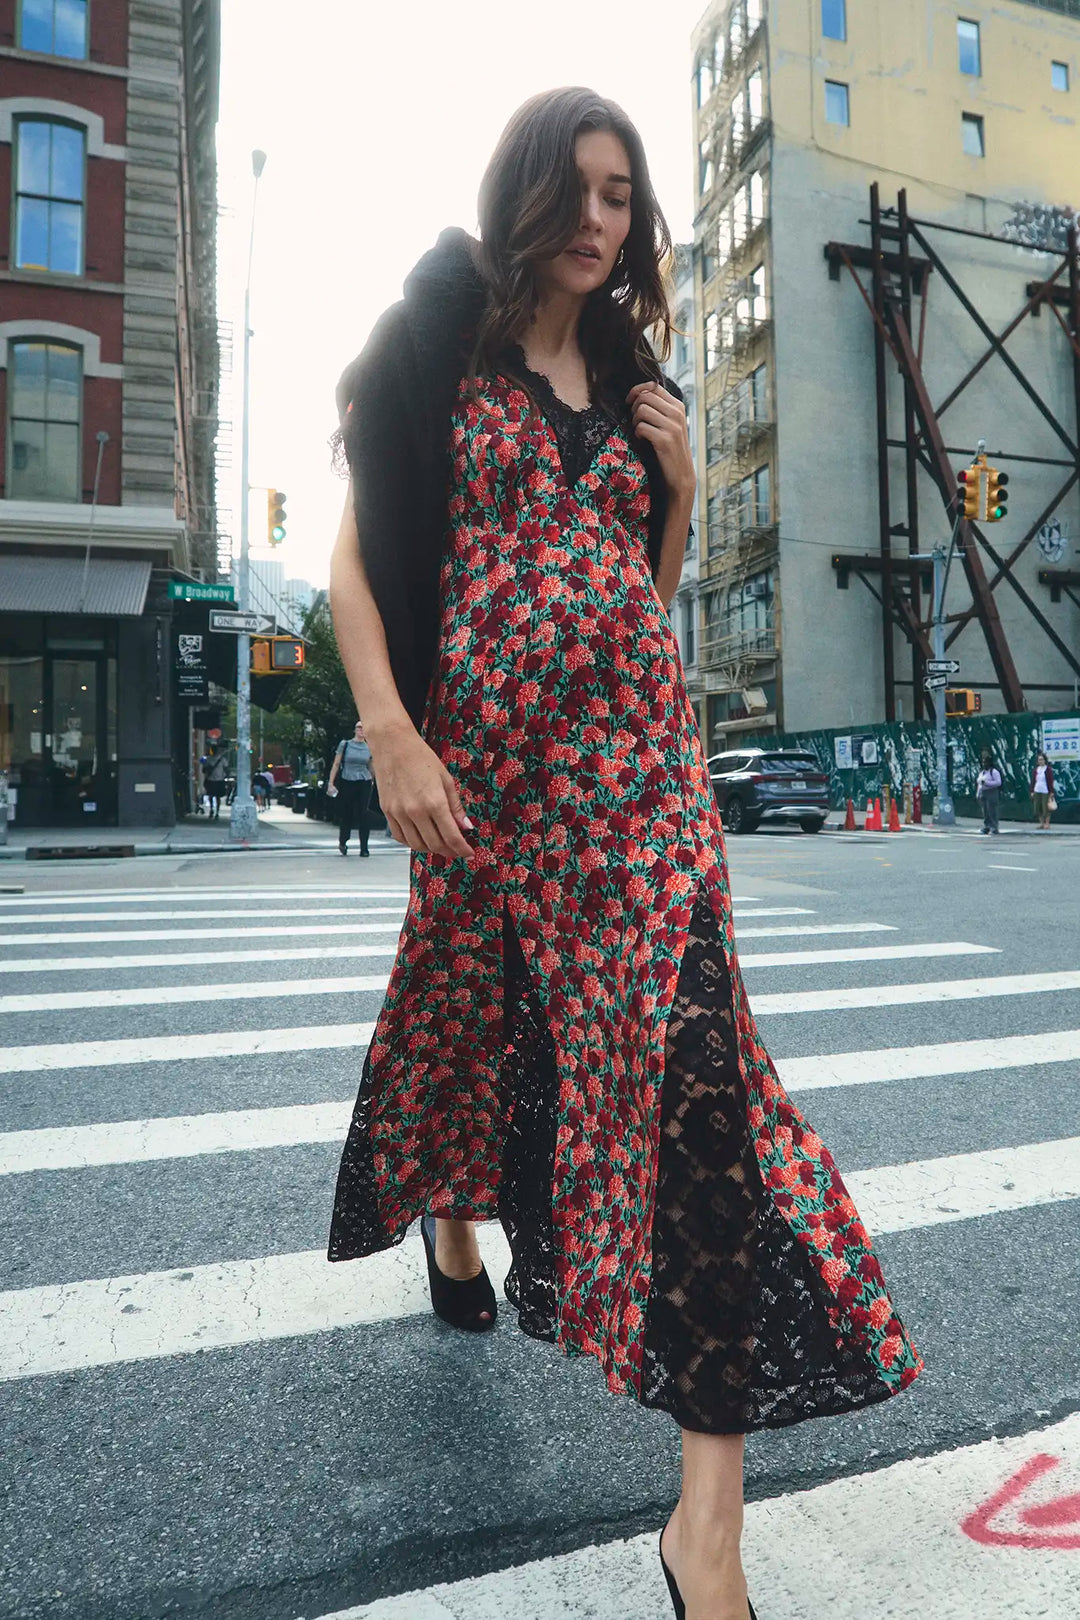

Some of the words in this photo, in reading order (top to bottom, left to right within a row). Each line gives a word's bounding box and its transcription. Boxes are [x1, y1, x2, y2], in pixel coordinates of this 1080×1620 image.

[174, 585, 183, 597] W
[186, 586, 230, 601] Broadway
[217, 616, 235, 626] ONE
[244, 618, 263, 628] WAY
[294, 645, 303, 665] 3
